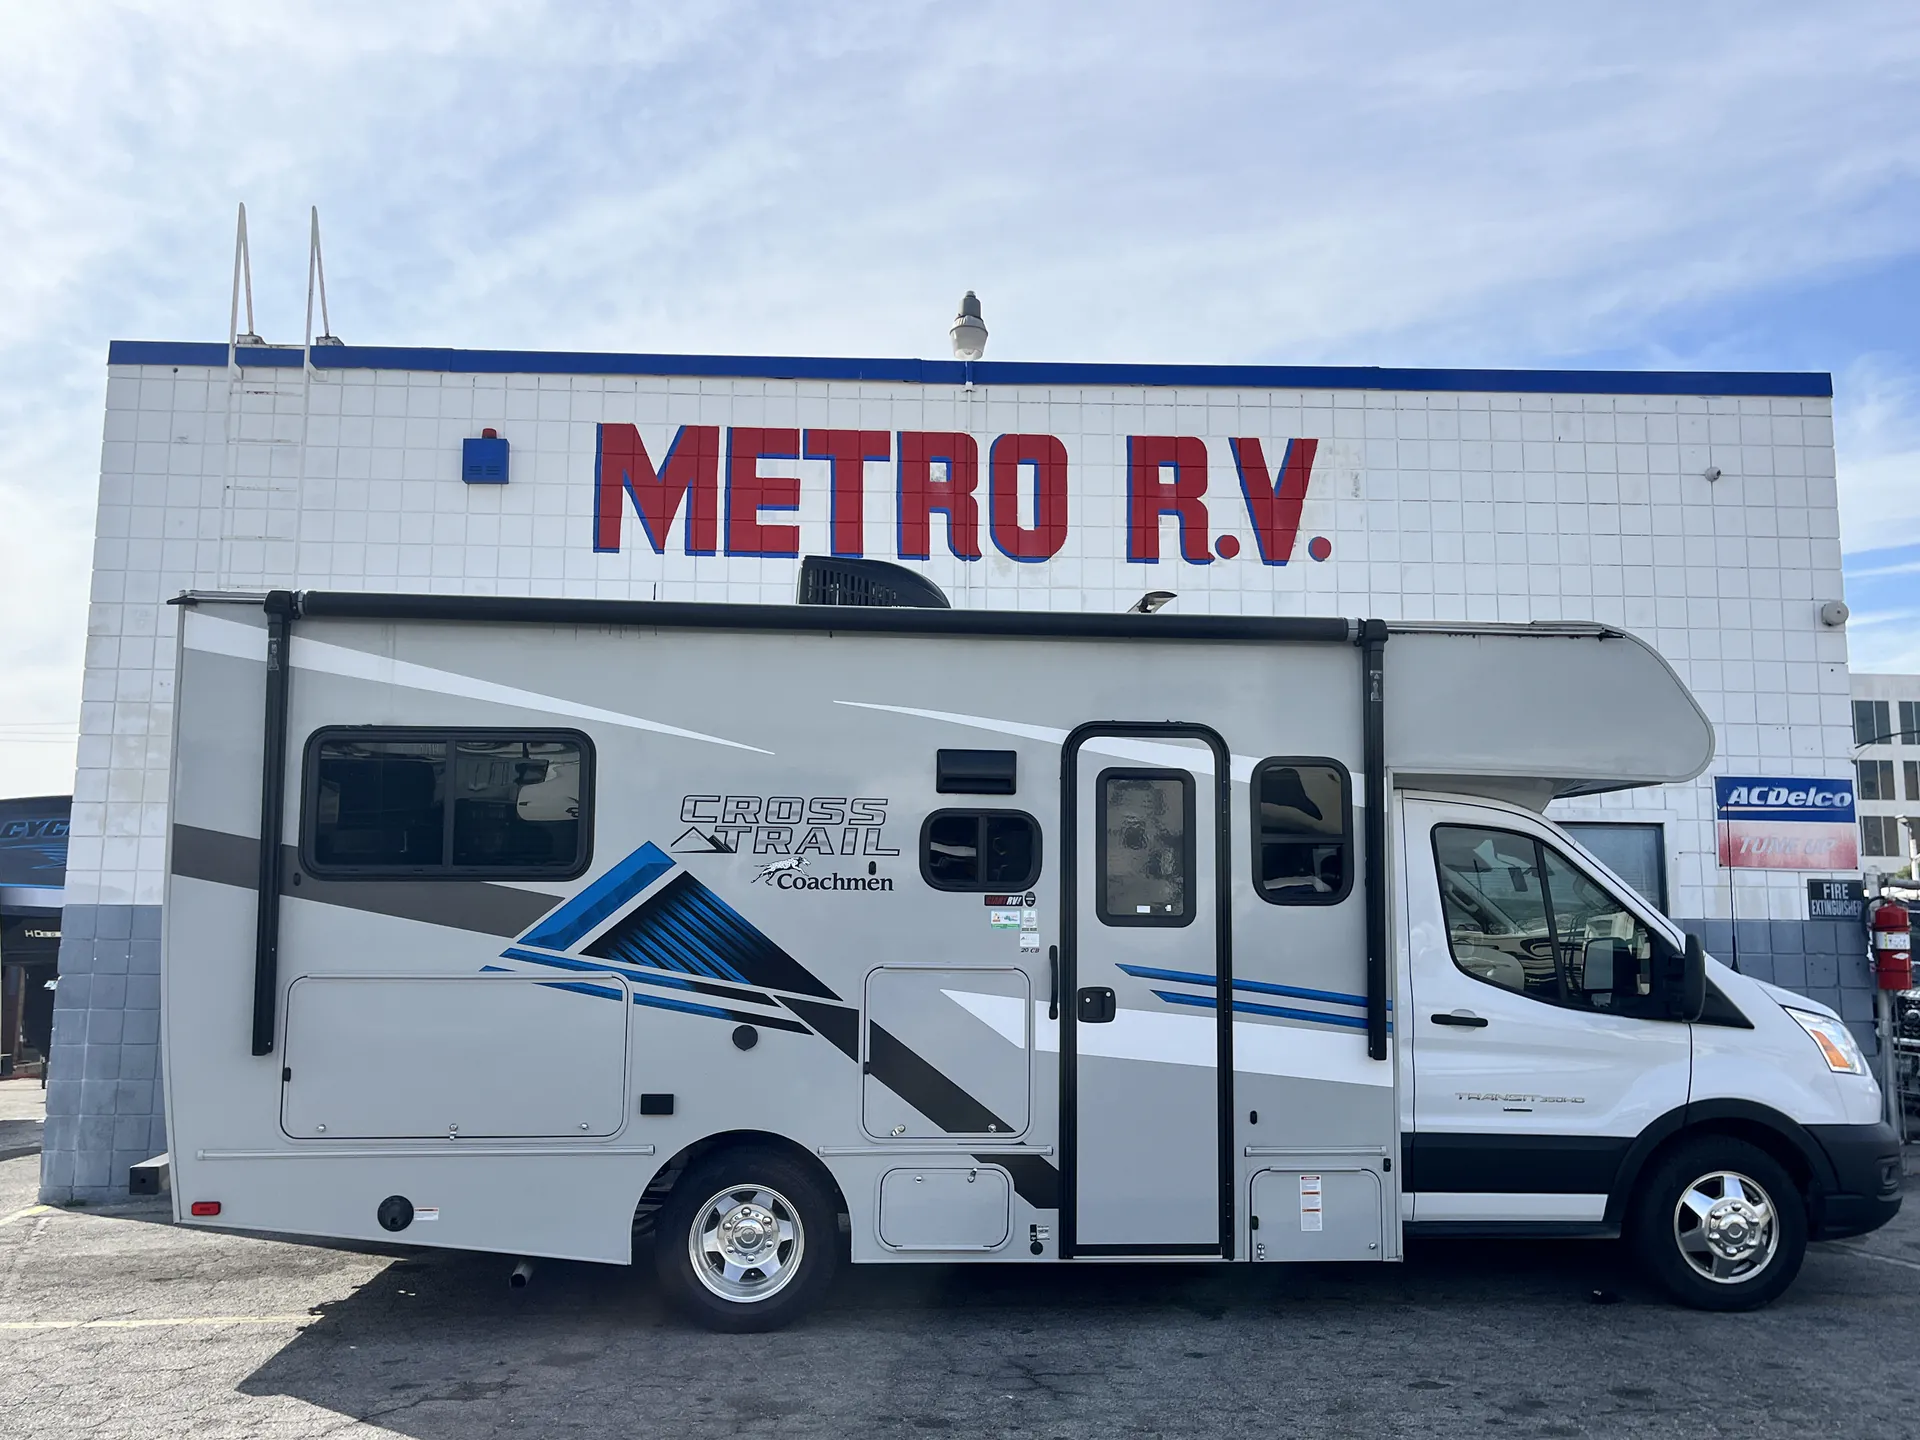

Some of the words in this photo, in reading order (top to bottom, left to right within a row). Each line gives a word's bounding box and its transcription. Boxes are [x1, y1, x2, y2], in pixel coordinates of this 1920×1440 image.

[593, 423, 1068, 563] METRO
[1125, 435, 1332, 567] R.V.
[1727, 786, 1852, 808] ACDelco
[680, 795, 888, 826] CROSS
[0, 818, 69, 839] CYC
[714, 826, 900, 856] TRAIL
[1740, 836, 1799, 855] TUNE
[1804, 837, 1837, 855] UP
[777, 872, 894, 892] Coachmen
[1823, 883, 1849, 899] FIRE
[1811, 899, 1863, 916] EXTINGUISHER
[1455, 1092, 1541, 1102] TRANSIT
